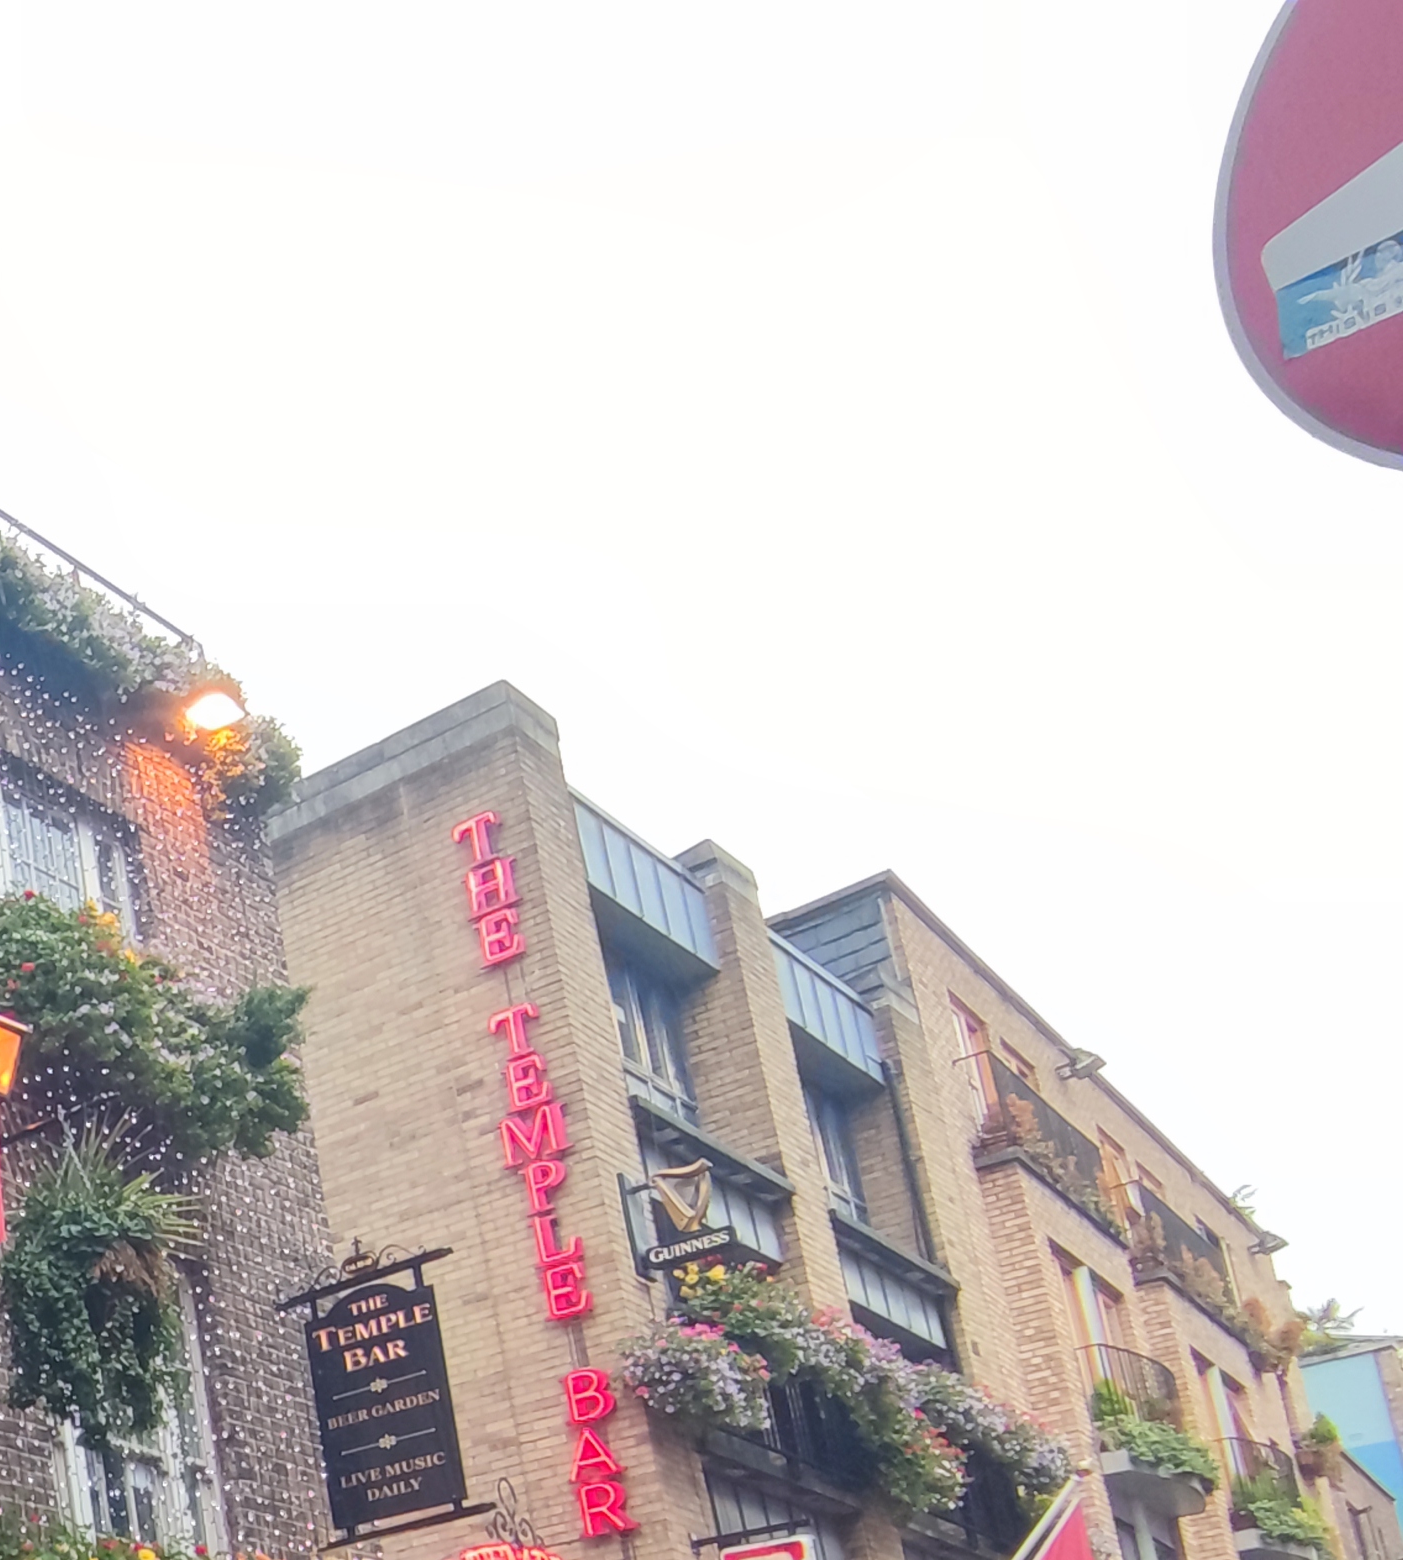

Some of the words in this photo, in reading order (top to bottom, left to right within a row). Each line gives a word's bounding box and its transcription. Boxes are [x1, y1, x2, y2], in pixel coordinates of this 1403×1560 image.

[1307, 316, 1357, 346] THIS
[452, 809, 526, 968] THE
[488, 1001, 594, 1321] TEMPLE
[649, 1231, 730, 1263] GUINNESS
[348, 1294, 389, 1316] THE
[312, 1303, 433, 1352] TEMPLE
[343, 1339, 409, 1373] BAR
[327, 1408, 370, 1430] BEER
[373, 1388, 440, 1417] GARDEN
[340, 1467, 382, 1488] LIVE
[384, 1452, 446, 1480] MUSIC
[563, 1368, 640, 1538] BAR
[366, 1477, 422, 1502] DAILY
